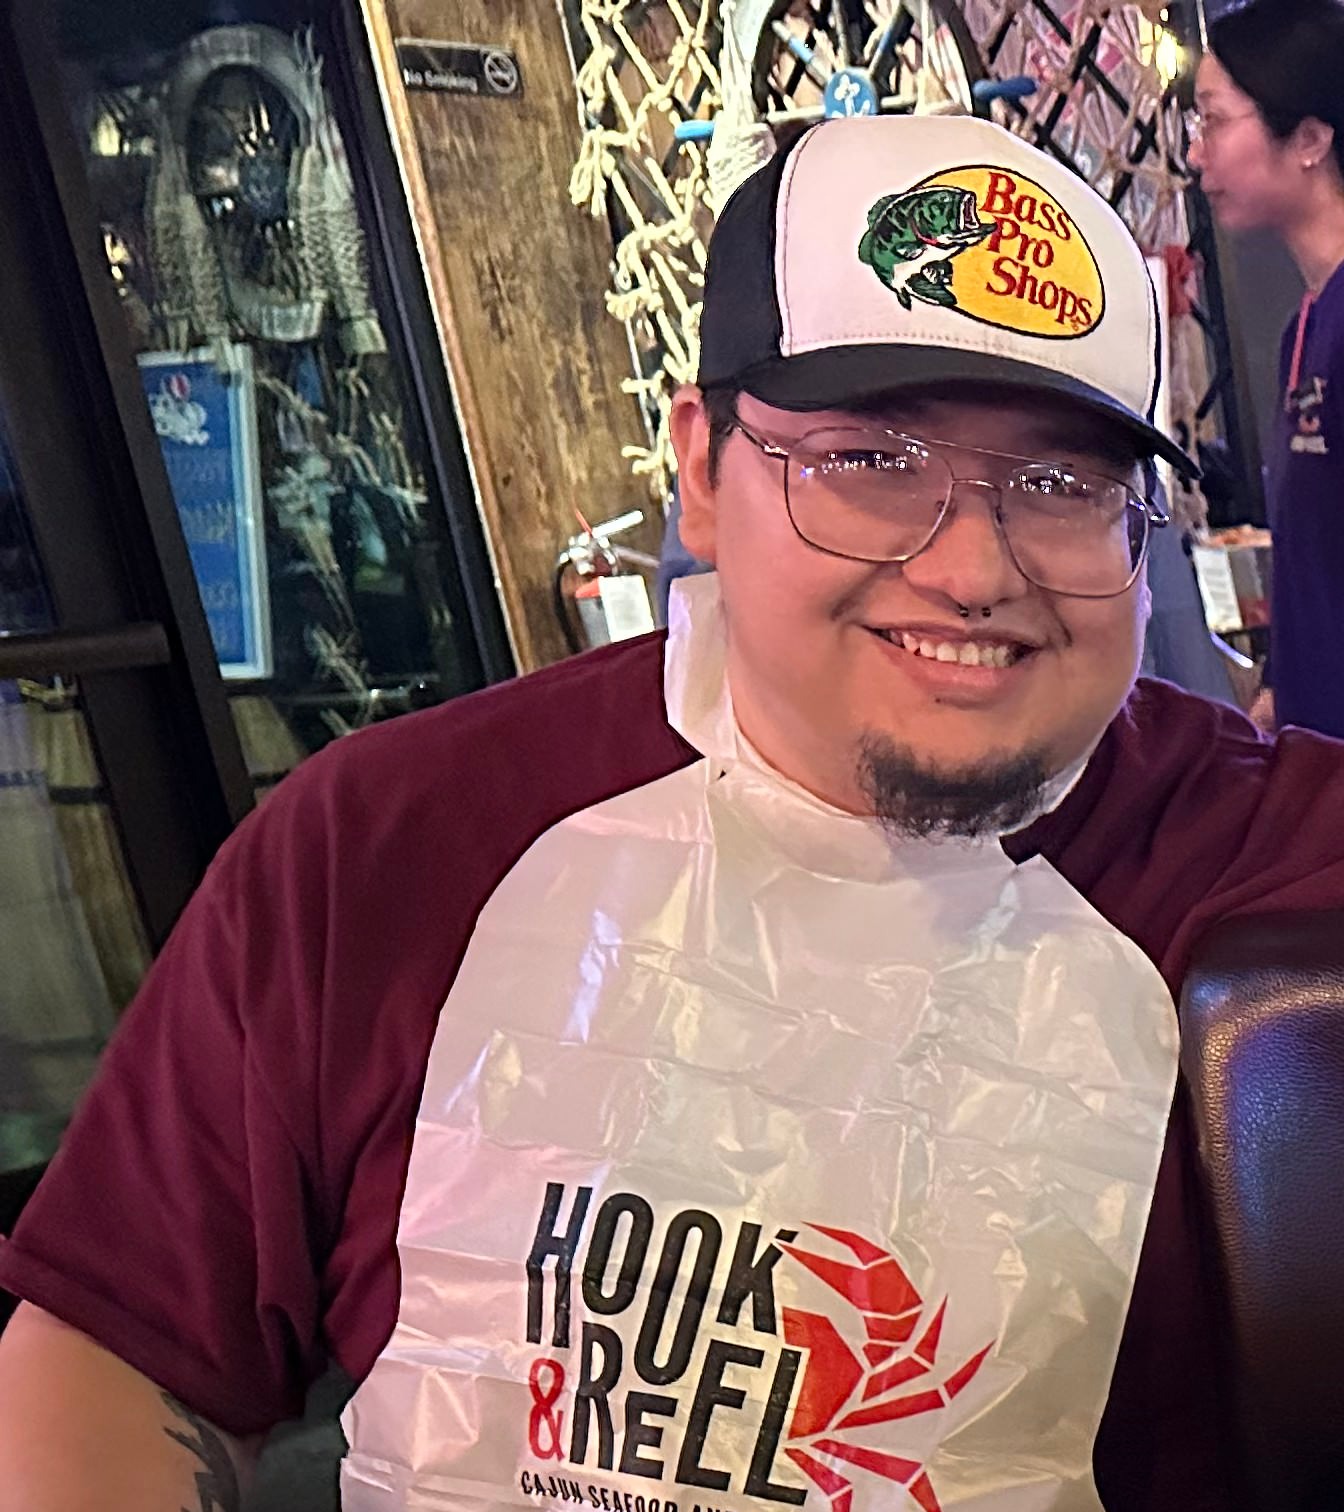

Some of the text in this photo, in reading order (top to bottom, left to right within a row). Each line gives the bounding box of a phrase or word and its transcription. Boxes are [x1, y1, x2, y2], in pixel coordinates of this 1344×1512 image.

[979, 172, 1071, 241] Bass
[987, 215, 1054, 268] Pro
[986, 257, 1092, 326] Shops
[525, 1182, 799, 1386] HOOK
[521, 1470, 583, 1504] CAJUN
